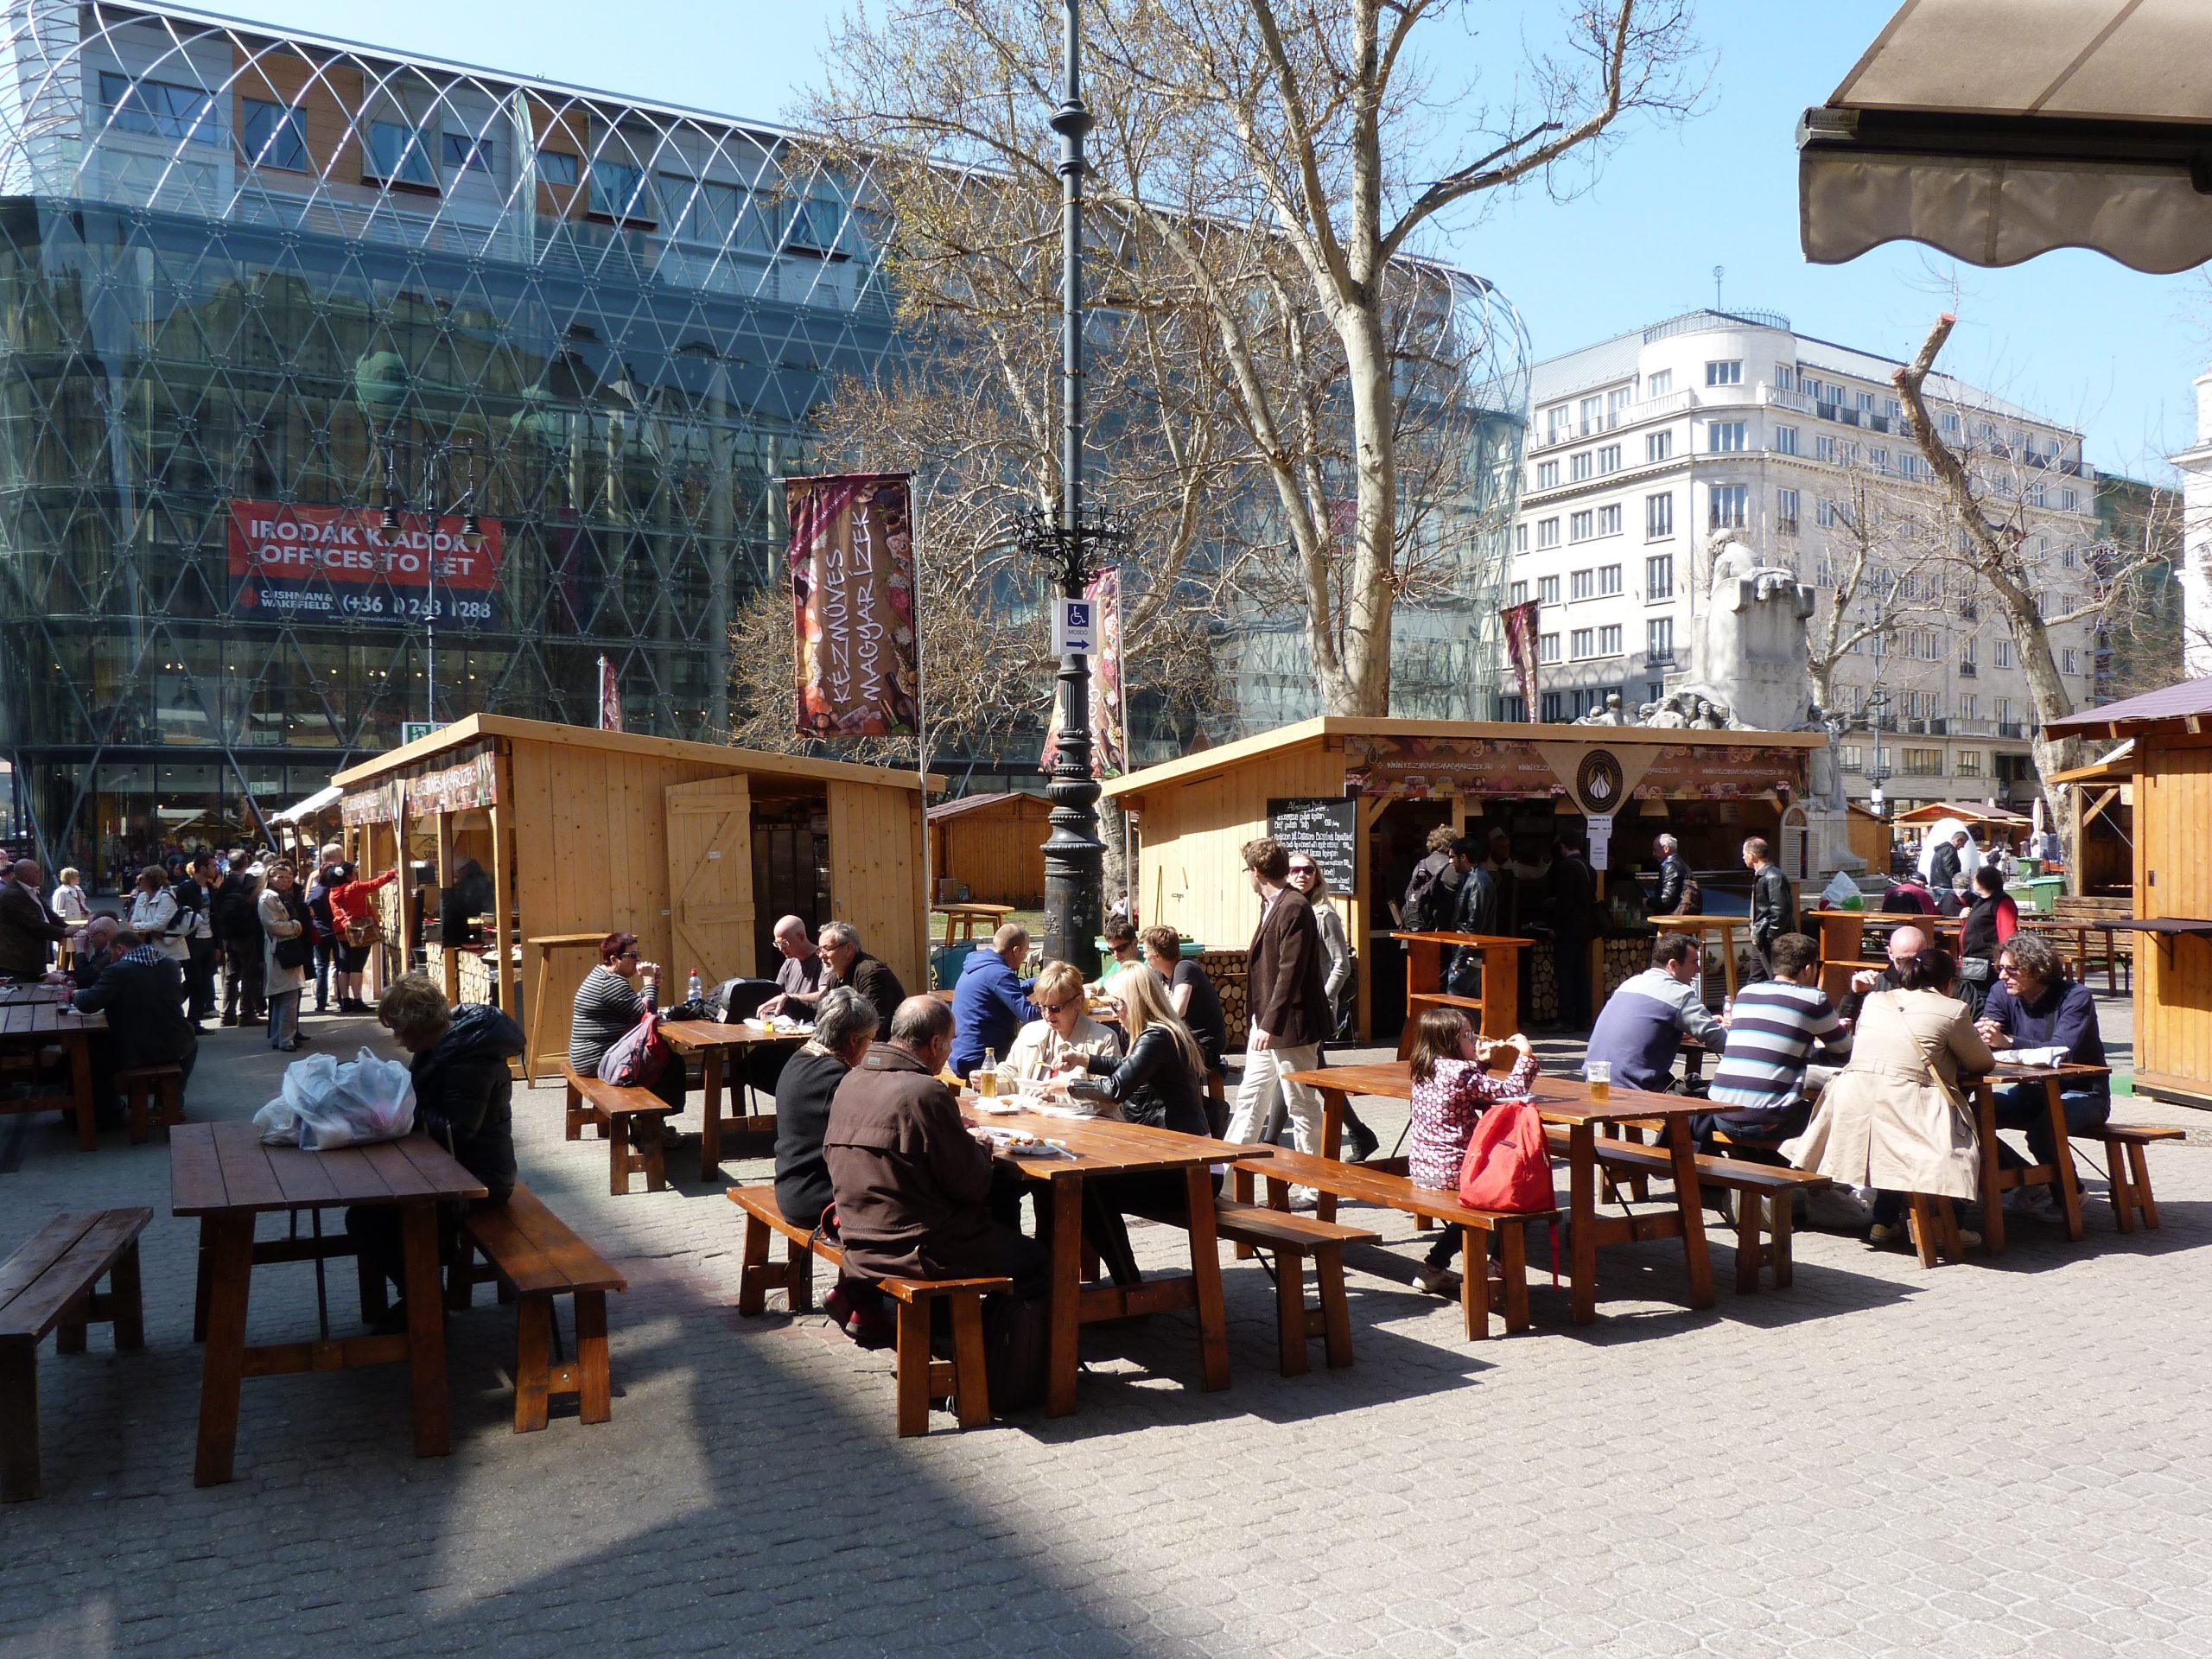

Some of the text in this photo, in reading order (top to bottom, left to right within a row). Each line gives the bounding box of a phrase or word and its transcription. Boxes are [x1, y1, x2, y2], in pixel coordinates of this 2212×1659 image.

[251, 519, 359, 544] IRODÁK
[366, 527, 470, 553] KADÓK
[260, 544, 374, 569] OFFICES
[381, 552, 420, 572] TO
[261, 599, 331, 610] WAKEFIELD
[451, 601, 491, 619] 1288
[848, 506, 884, 702] MAGYAR ÍZEK
[823, 548, 852, 704] KÉZMŰVES
